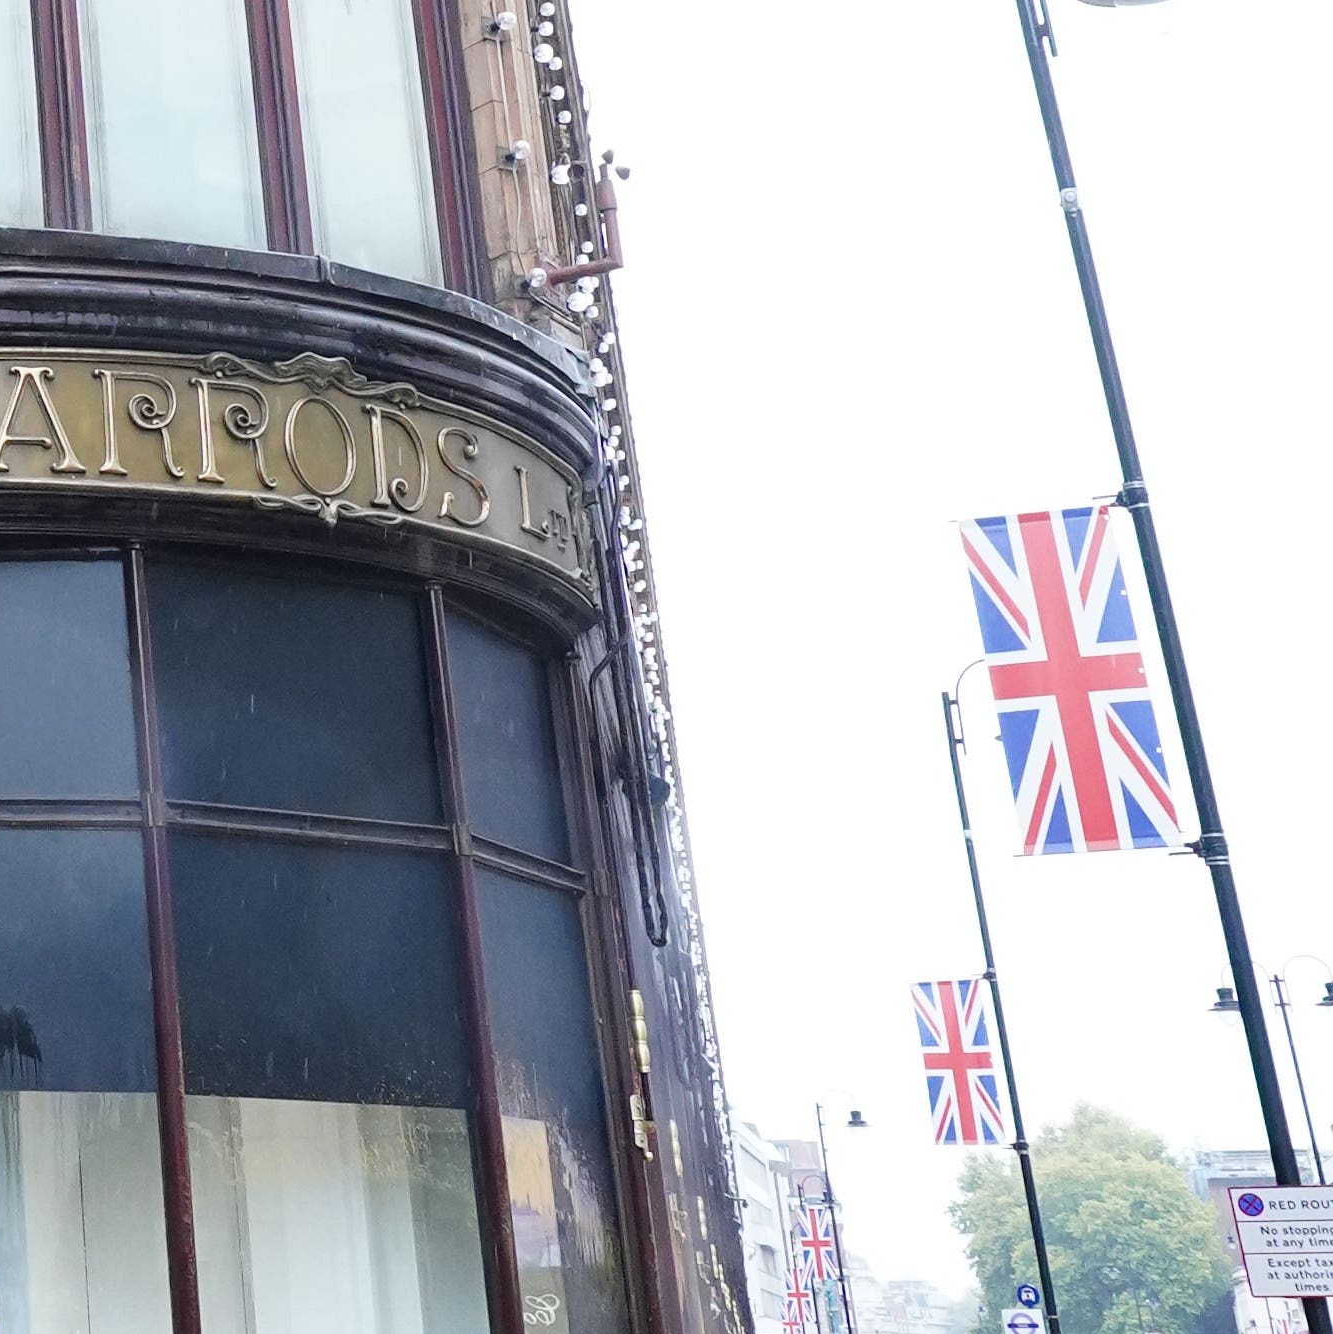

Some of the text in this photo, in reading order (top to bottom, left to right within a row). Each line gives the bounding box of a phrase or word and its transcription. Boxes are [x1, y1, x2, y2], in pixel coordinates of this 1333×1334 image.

[1268, 1200, 1296, 1210] RED
[1260, 1226, 1278, 1235] No
[1266, 1239, 1279, 1247] at
[1283, 1240, 1304, 1248] any
[1267, 1258, 1311, 1269] Except
[1267, 1271, 1280, 1280] at
[1295, 1283, 1329, 1292] times
